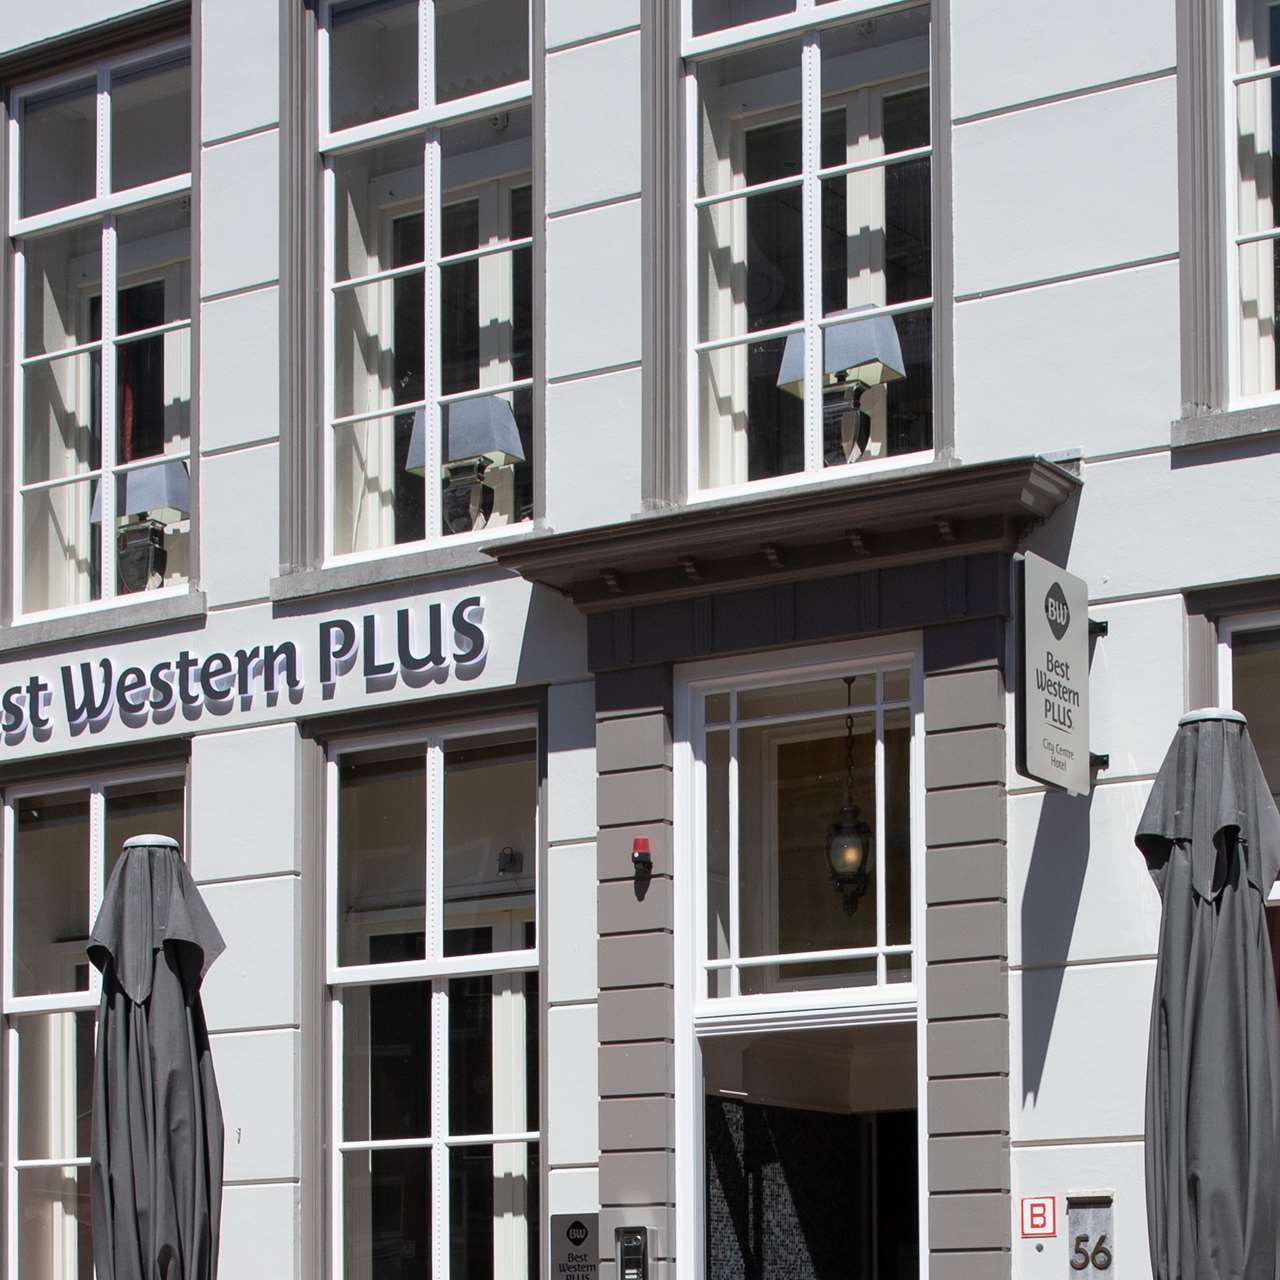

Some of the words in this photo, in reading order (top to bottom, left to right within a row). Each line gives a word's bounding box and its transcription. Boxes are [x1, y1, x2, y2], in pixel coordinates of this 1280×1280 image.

[1047, 596, 1069, 625] BW
[61, 640, 301, 721] Western
[319, 596, 486, 683] PLUS
[1046, 651, 1070, 681] Best
[1036, 668, 1080, 707] Western
[1044, 699, 1072, 729] PLUS
[1042, 737, 1055, 756] City
[1055, 742, 1074, 761] Centre
[1050, 756, 1067, 772] Hotel
[1030, 1203, 1047, 1228] B
[569, 1228, 586, 1239] BW
[567, 1253, 588, 1262] Best
[1070, 1234, 1112, 1270] 56
[559, 1263, 597, 1272] Western
